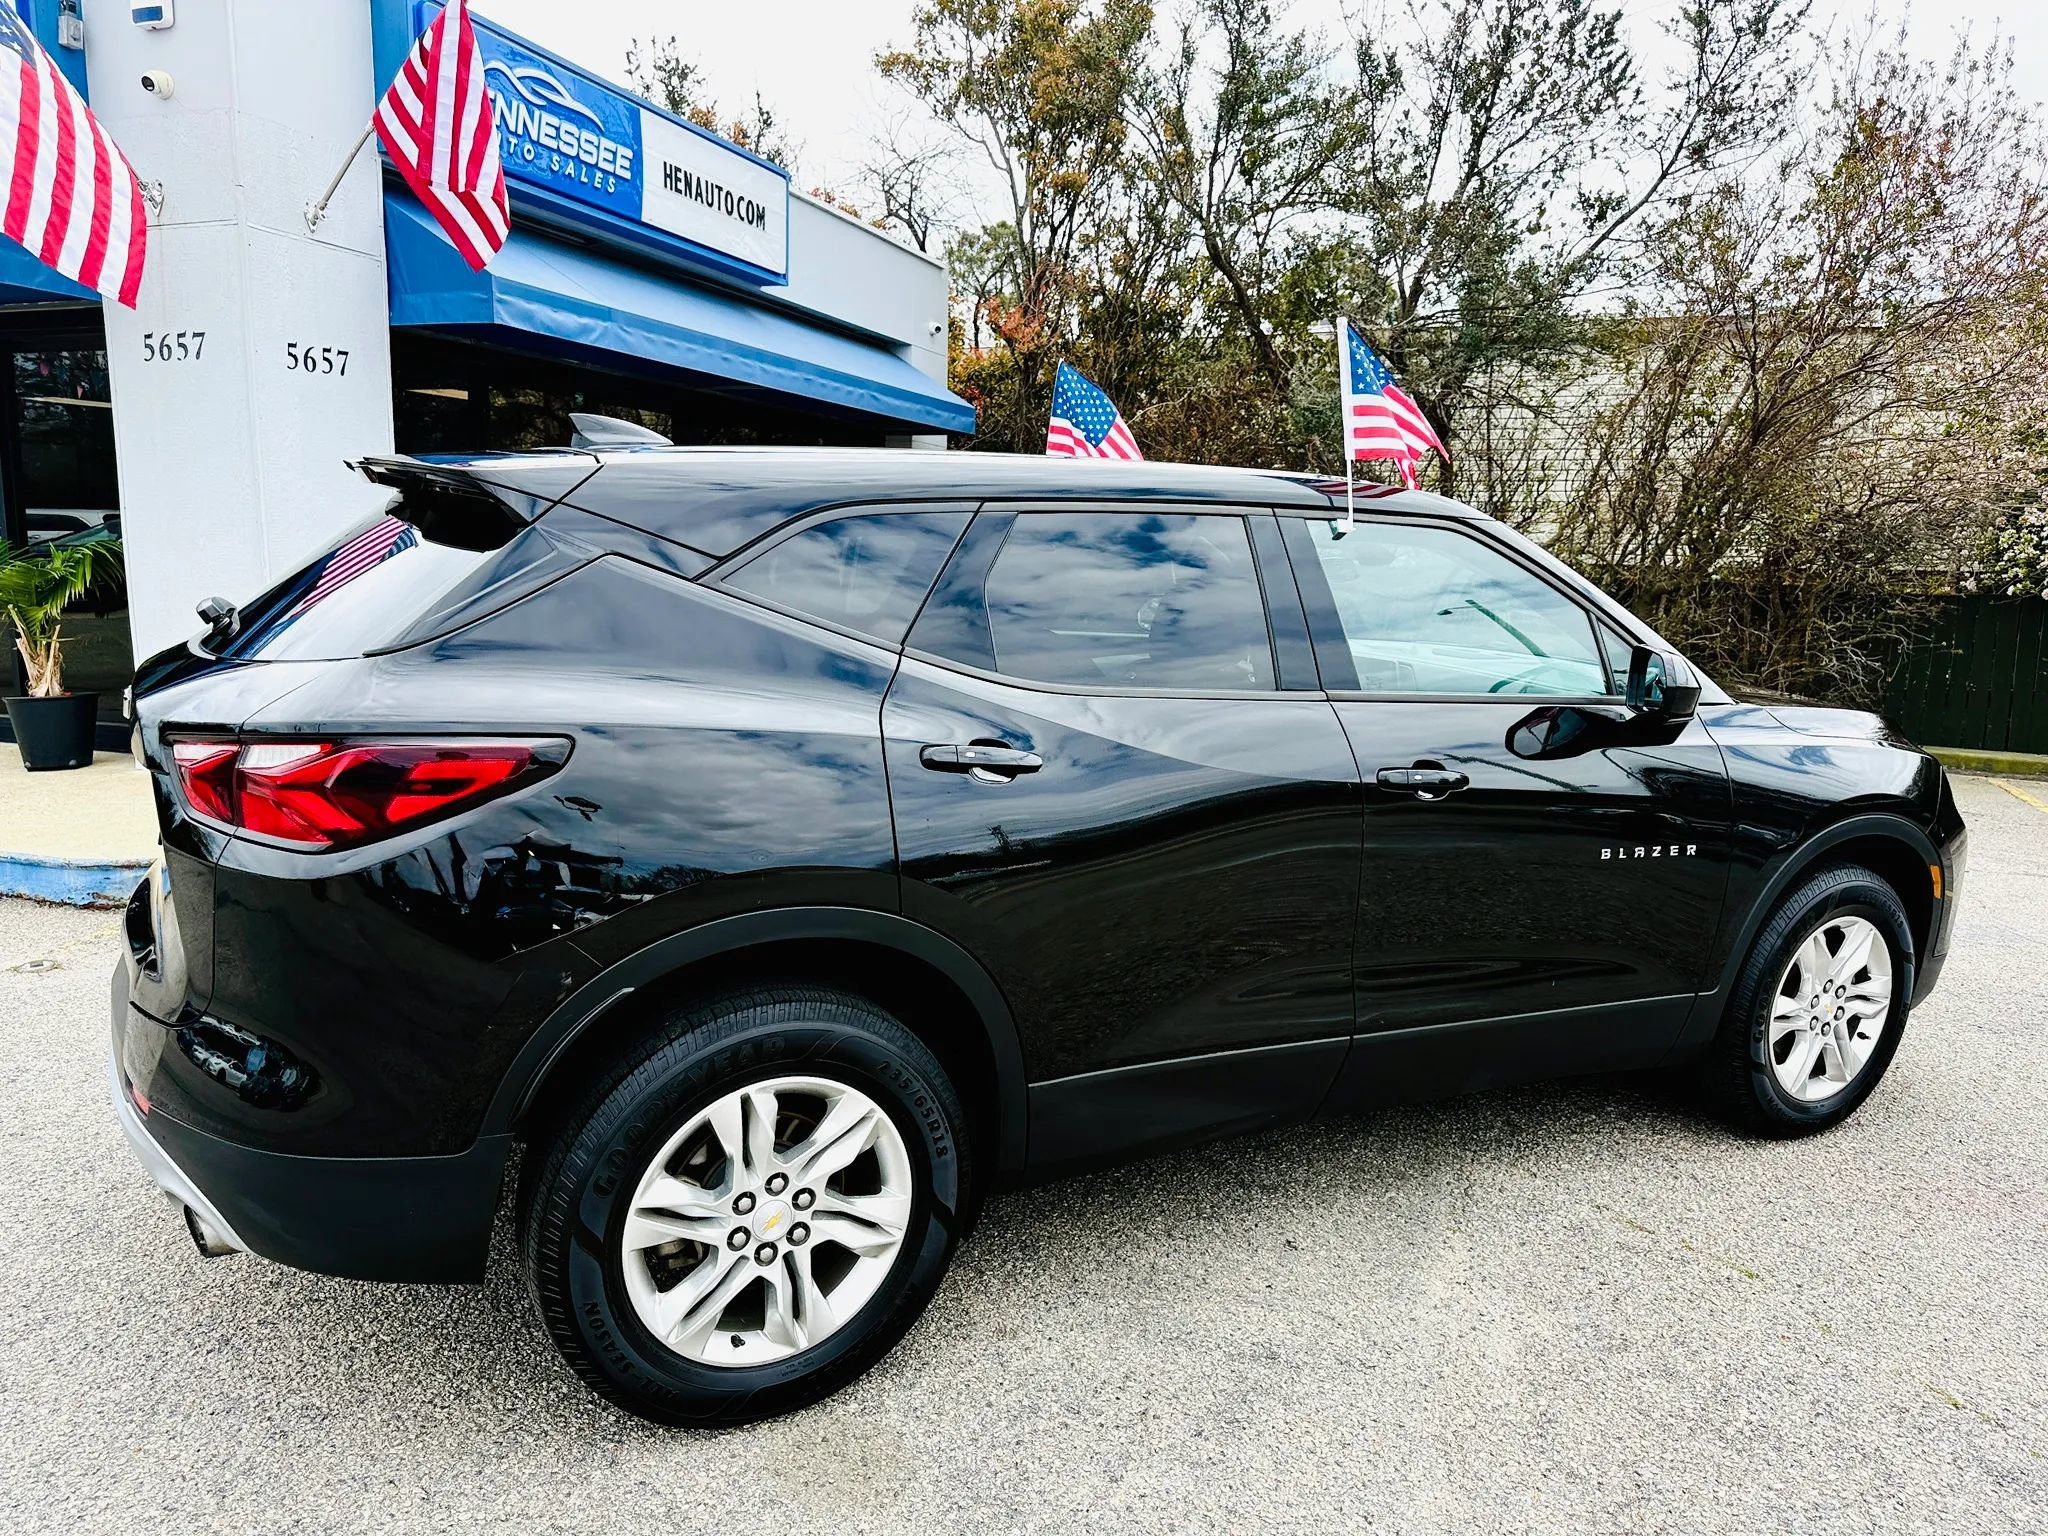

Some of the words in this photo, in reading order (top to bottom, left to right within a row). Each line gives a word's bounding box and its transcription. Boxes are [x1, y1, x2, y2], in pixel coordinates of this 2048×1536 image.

[550, 154, 617, 193] SALES
[143, 330, 206, 362] 5657
[286, 341, 349, 377] 5657
[1600, 844, 1697, 860] BLAZER
